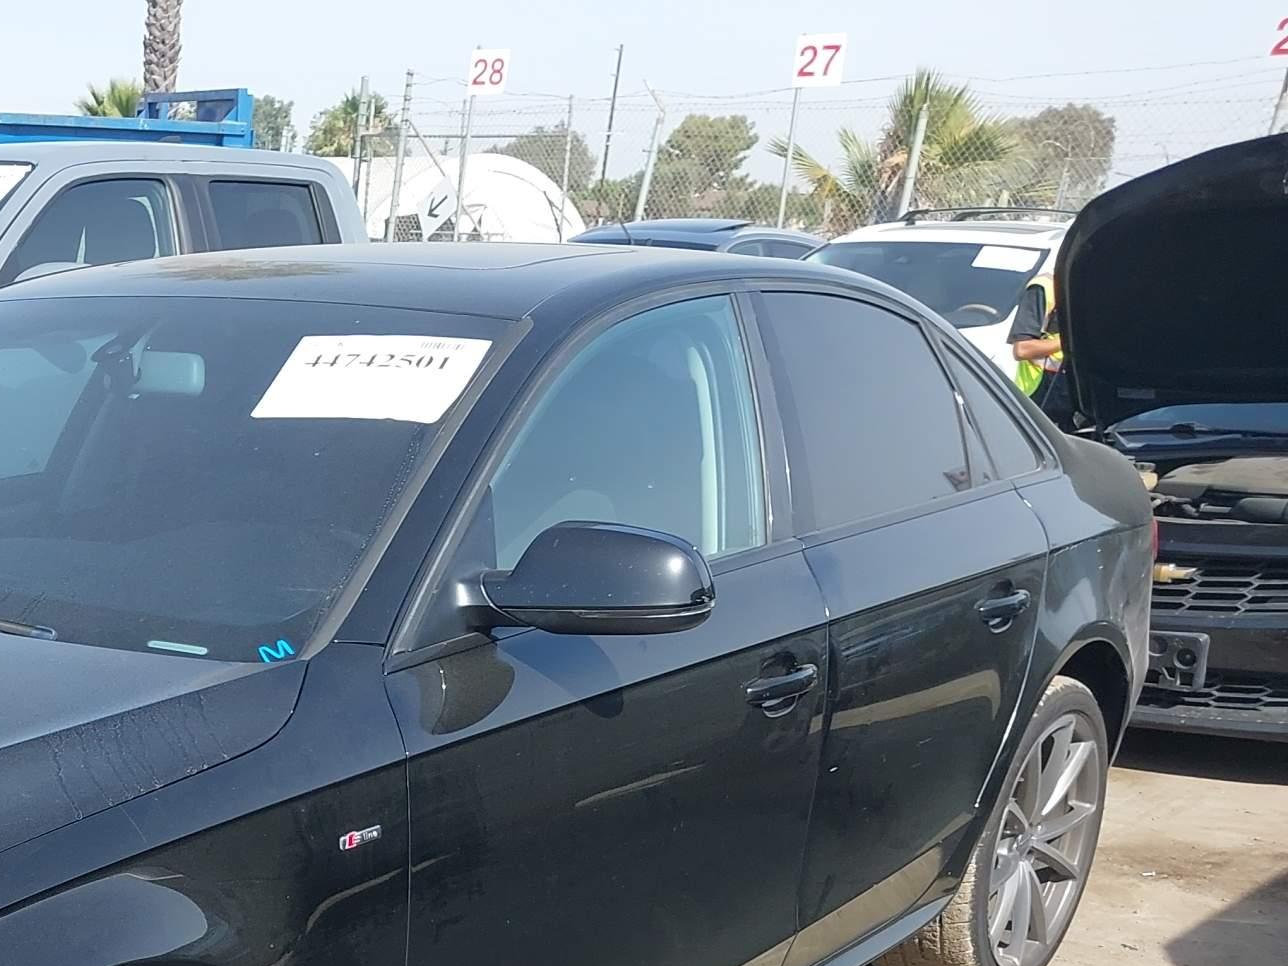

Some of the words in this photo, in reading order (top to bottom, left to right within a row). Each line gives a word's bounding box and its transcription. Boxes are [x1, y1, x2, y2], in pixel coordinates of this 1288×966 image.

[472, 58, 504, 85] 28
[797, 45, 841, 77] 27
[305, 354, 450, 369] 44742501
